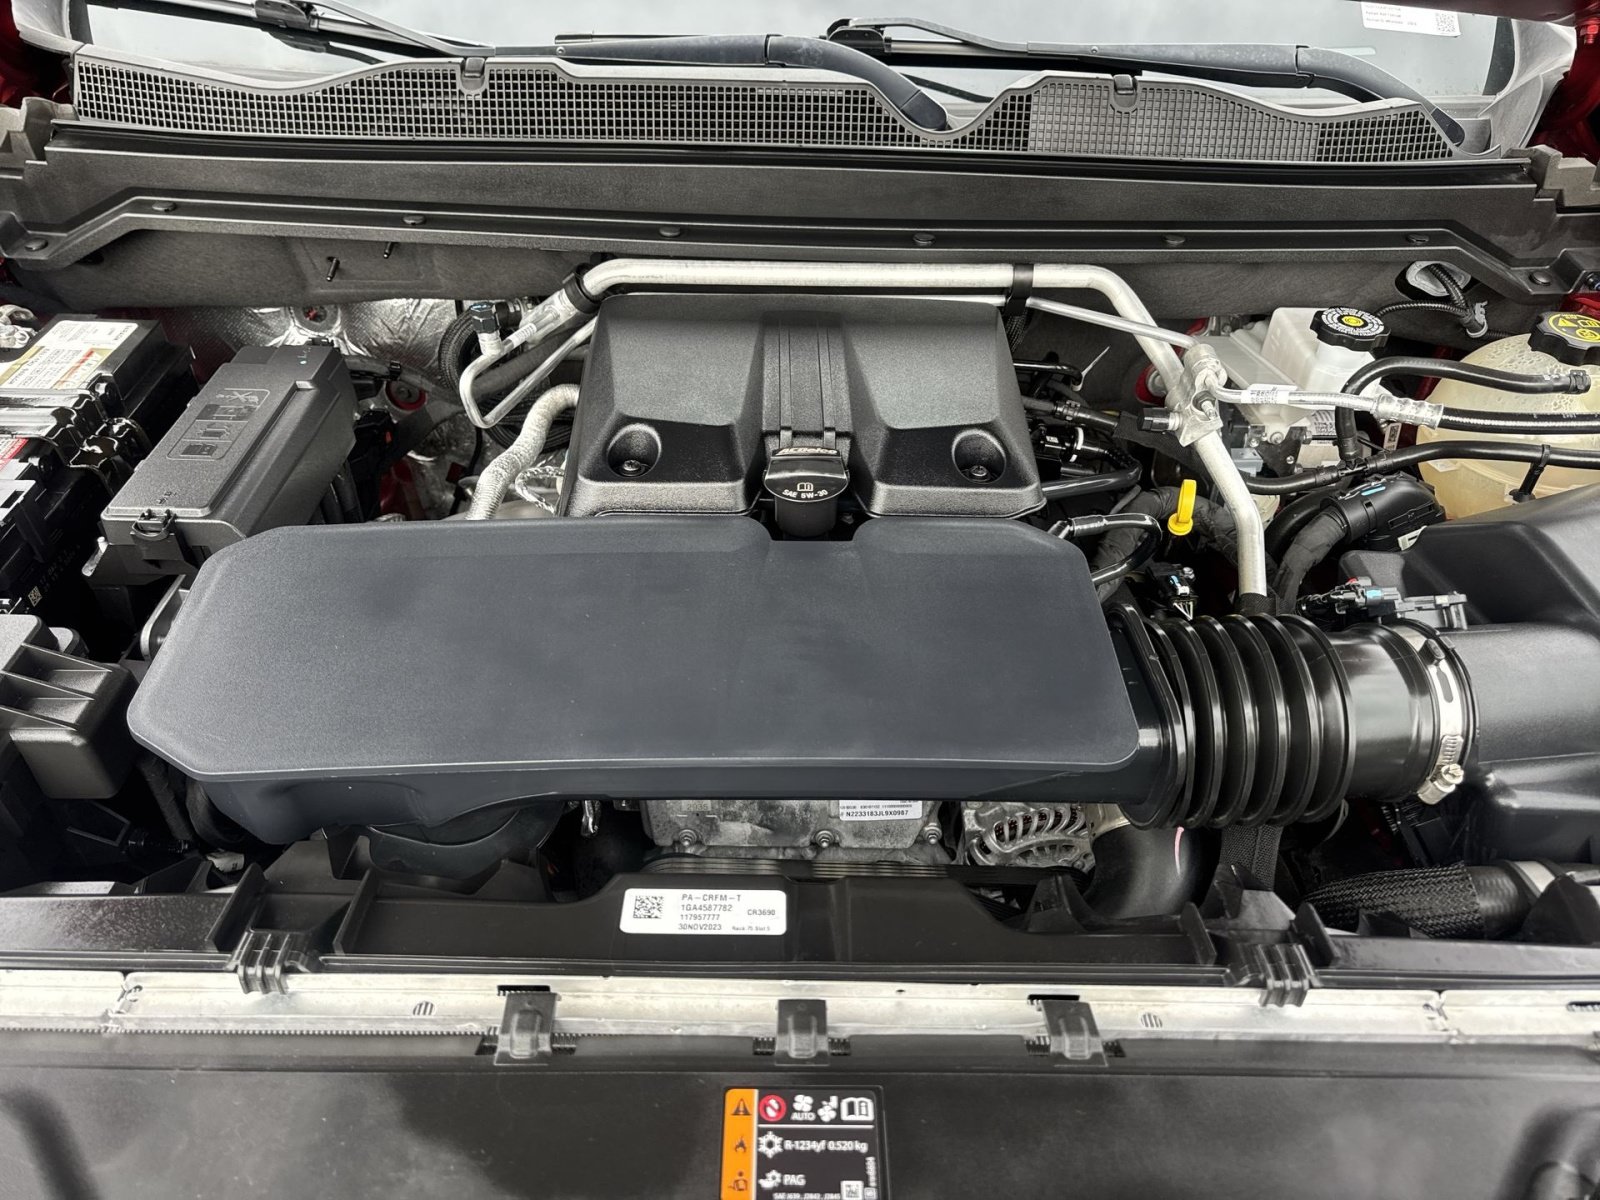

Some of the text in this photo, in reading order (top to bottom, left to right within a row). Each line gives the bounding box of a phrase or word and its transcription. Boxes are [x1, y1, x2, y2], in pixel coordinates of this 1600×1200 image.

[776, 448, 838, 456] ACDelco
[782, 489, 829, 499] SAE 5W-30
[790, 1112, 817, 1121] AUTO
[783, 1140, 869, 1154] R-1234yf 0.520 kg
[783, 1174, 806, 1186] PAG
